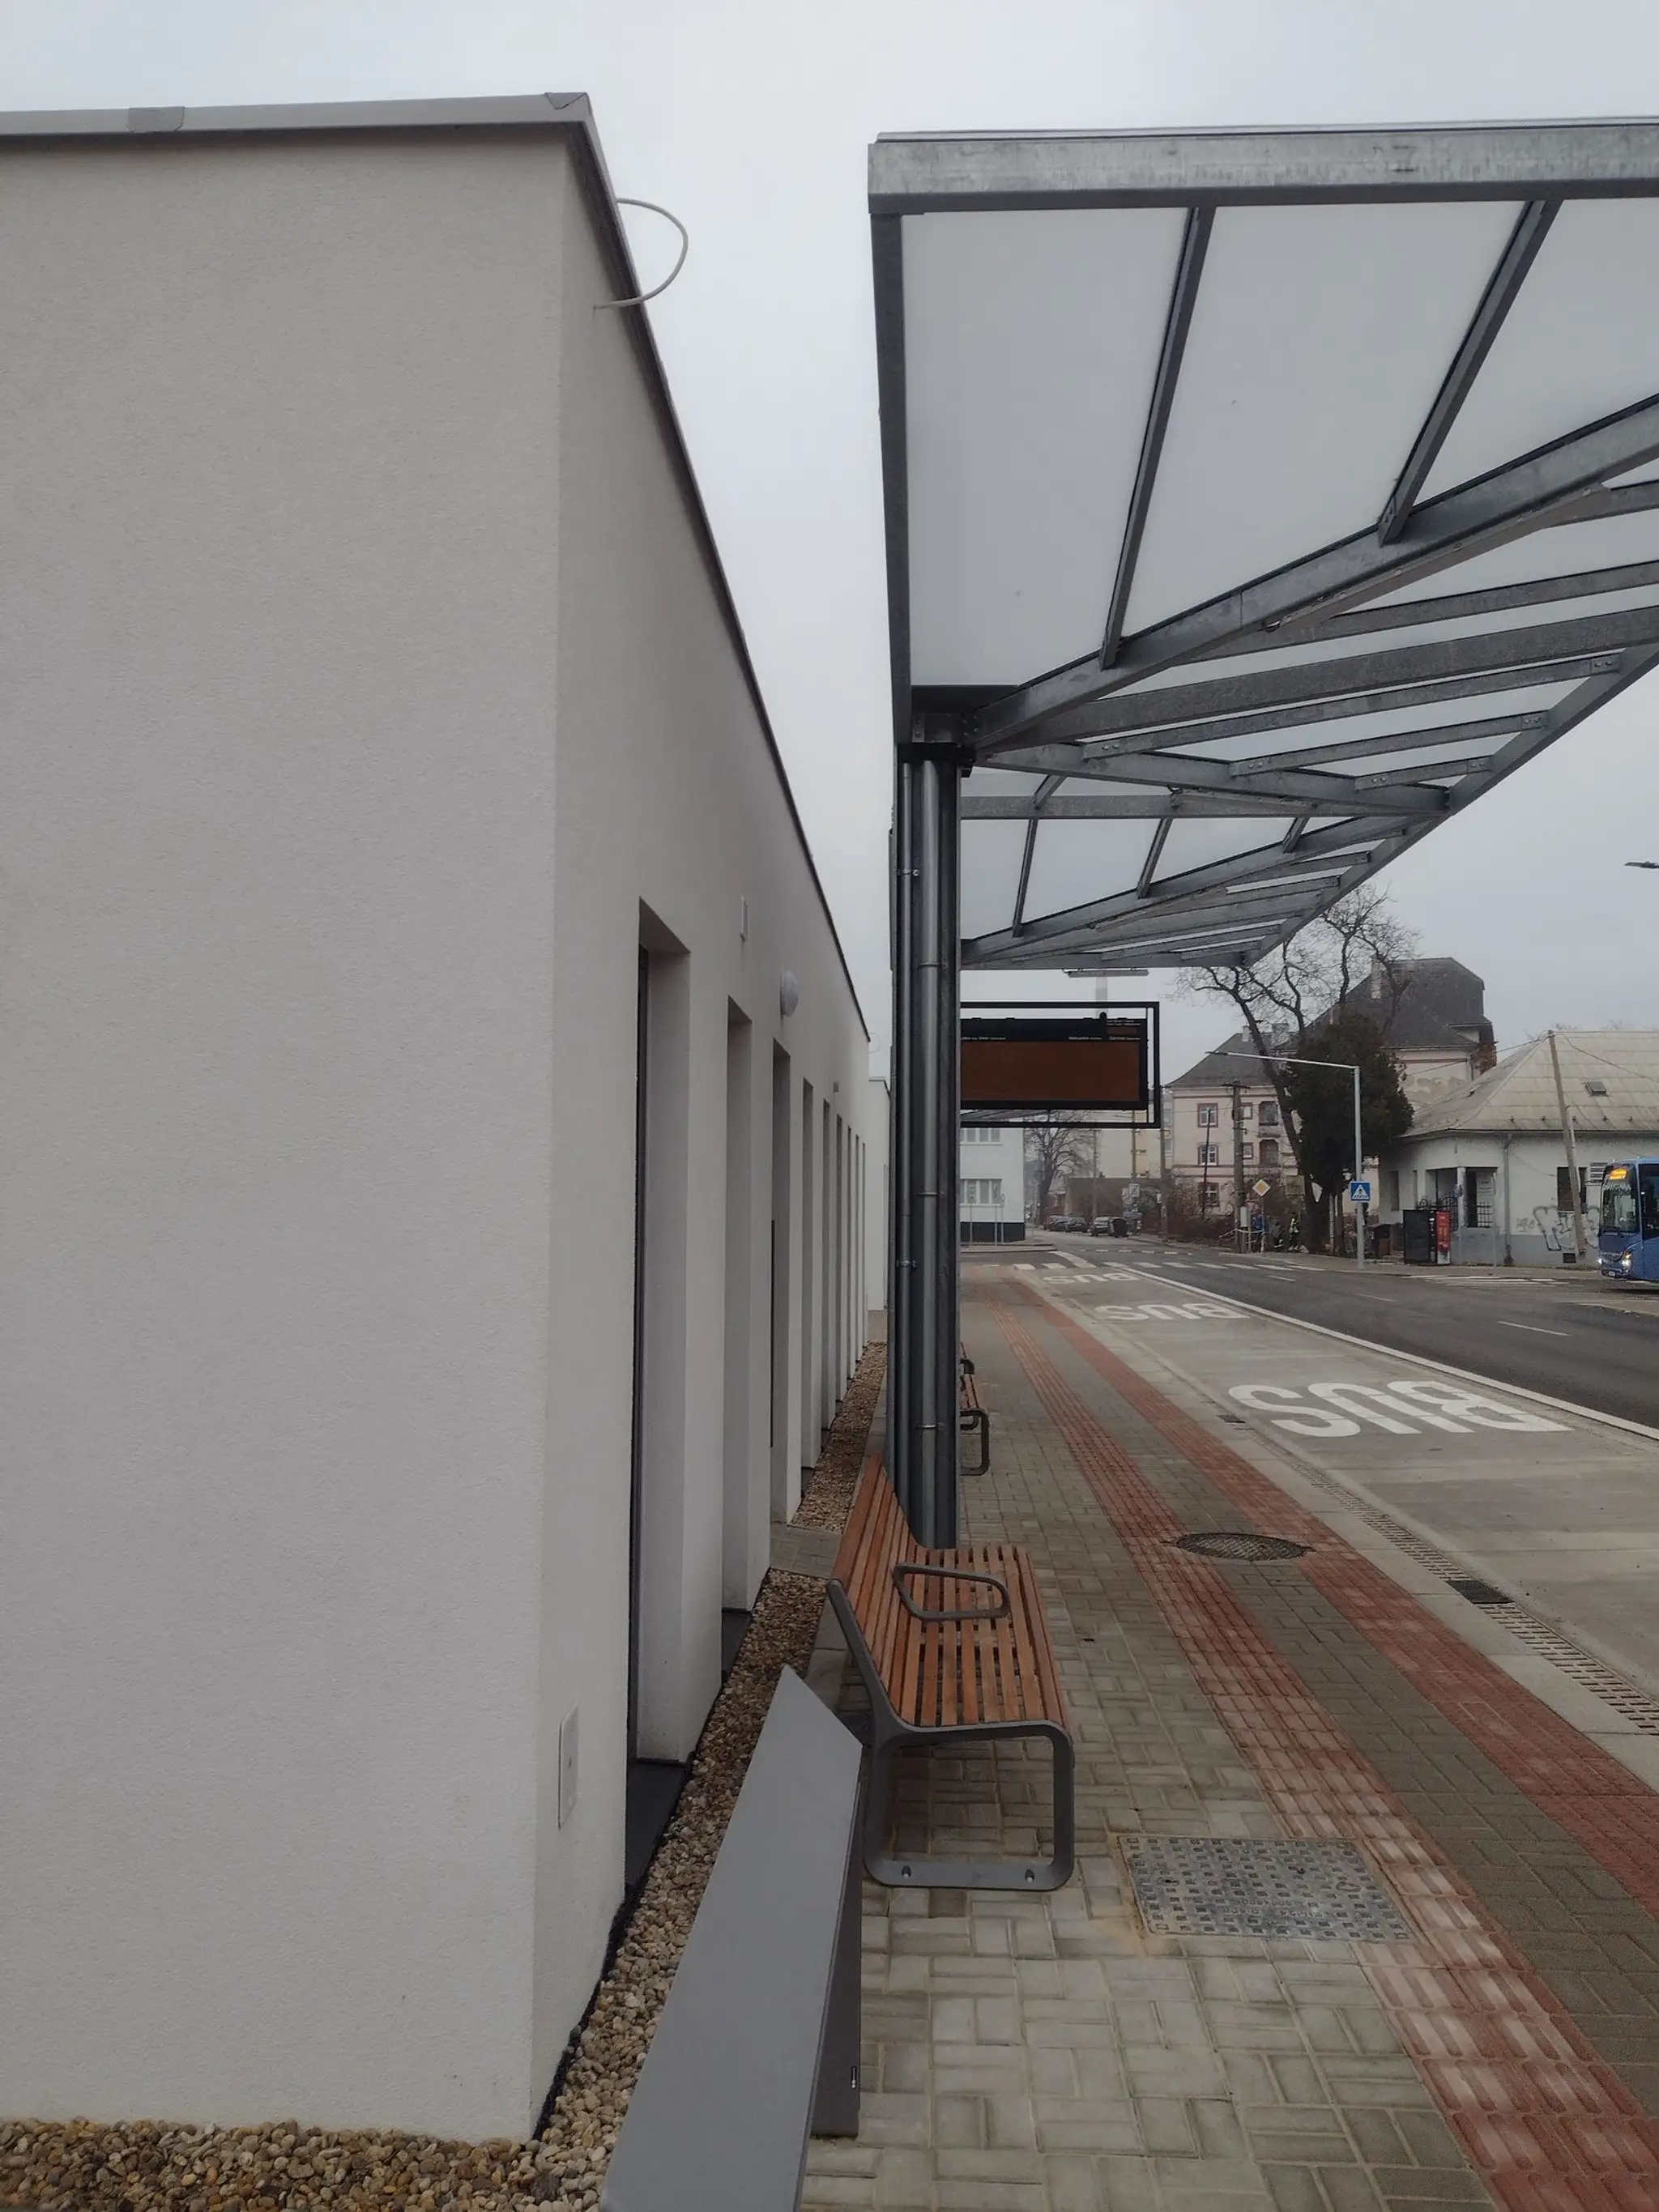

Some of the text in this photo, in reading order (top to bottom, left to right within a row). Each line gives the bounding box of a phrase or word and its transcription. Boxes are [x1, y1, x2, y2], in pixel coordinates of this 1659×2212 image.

[1043, 1272, 1138, 1284] BUS
[1095, 1303, 1251, 1320] BUS
[1229, 1380, 1575, 1437] BUS
